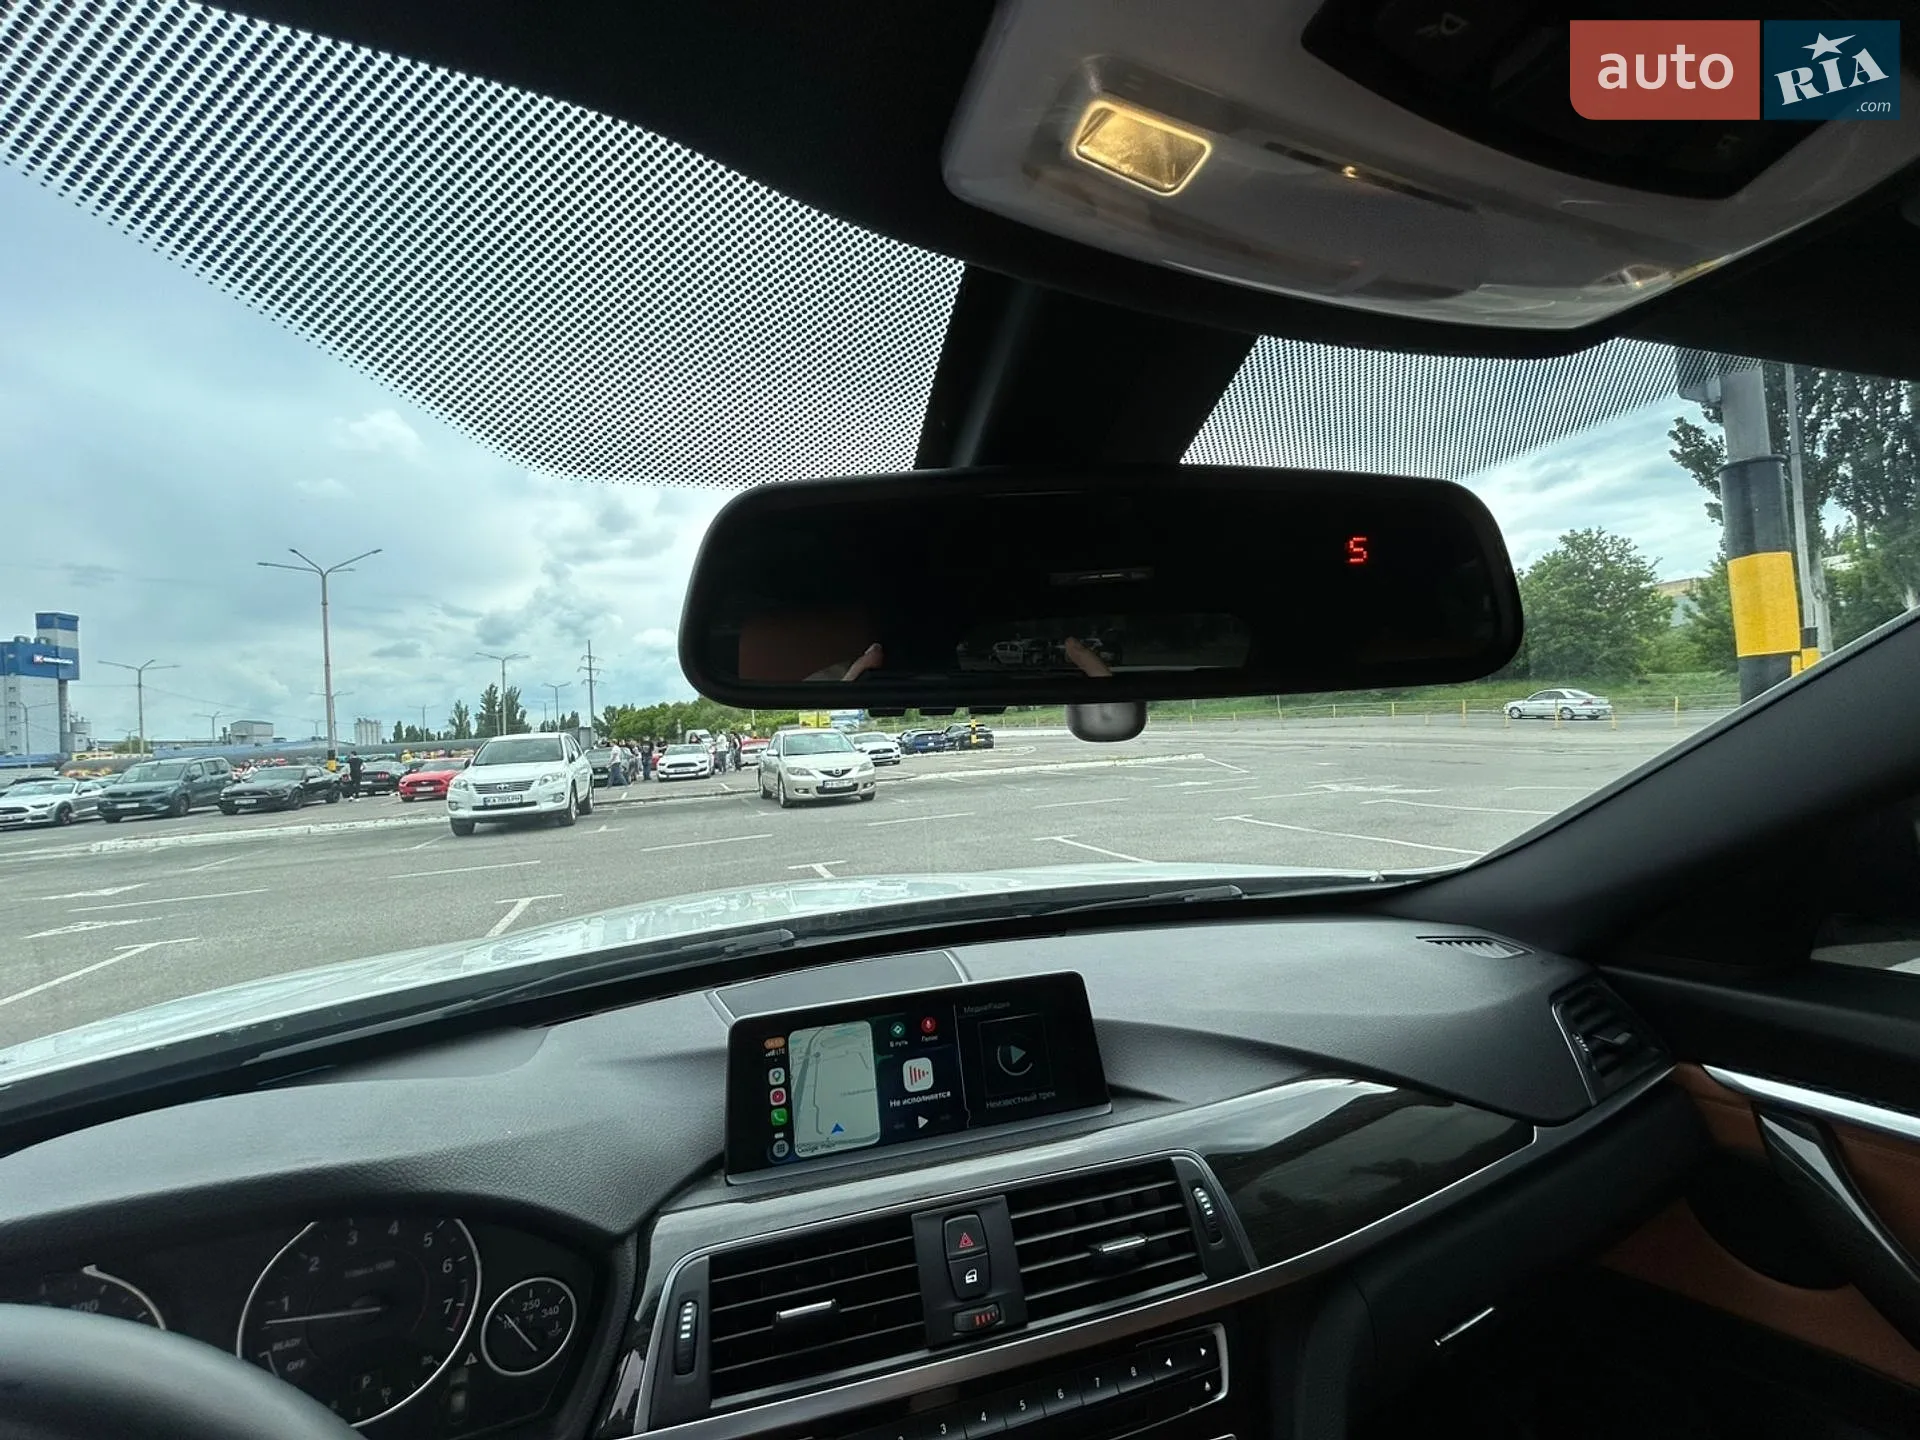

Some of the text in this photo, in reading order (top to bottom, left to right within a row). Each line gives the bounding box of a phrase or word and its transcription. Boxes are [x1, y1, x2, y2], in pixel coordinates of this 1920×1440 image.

[388, 1221, 399, 1237] 4
[347, 1230, 358, 1247] 3
[423, 1232, 433, 1247] 5
[309, 1256, 320, 1272] 2
[442, 1258, 453, 1273] 6
[281, 1296, 290, 1311] 1
[443, 1298, 455, 1315] 7
